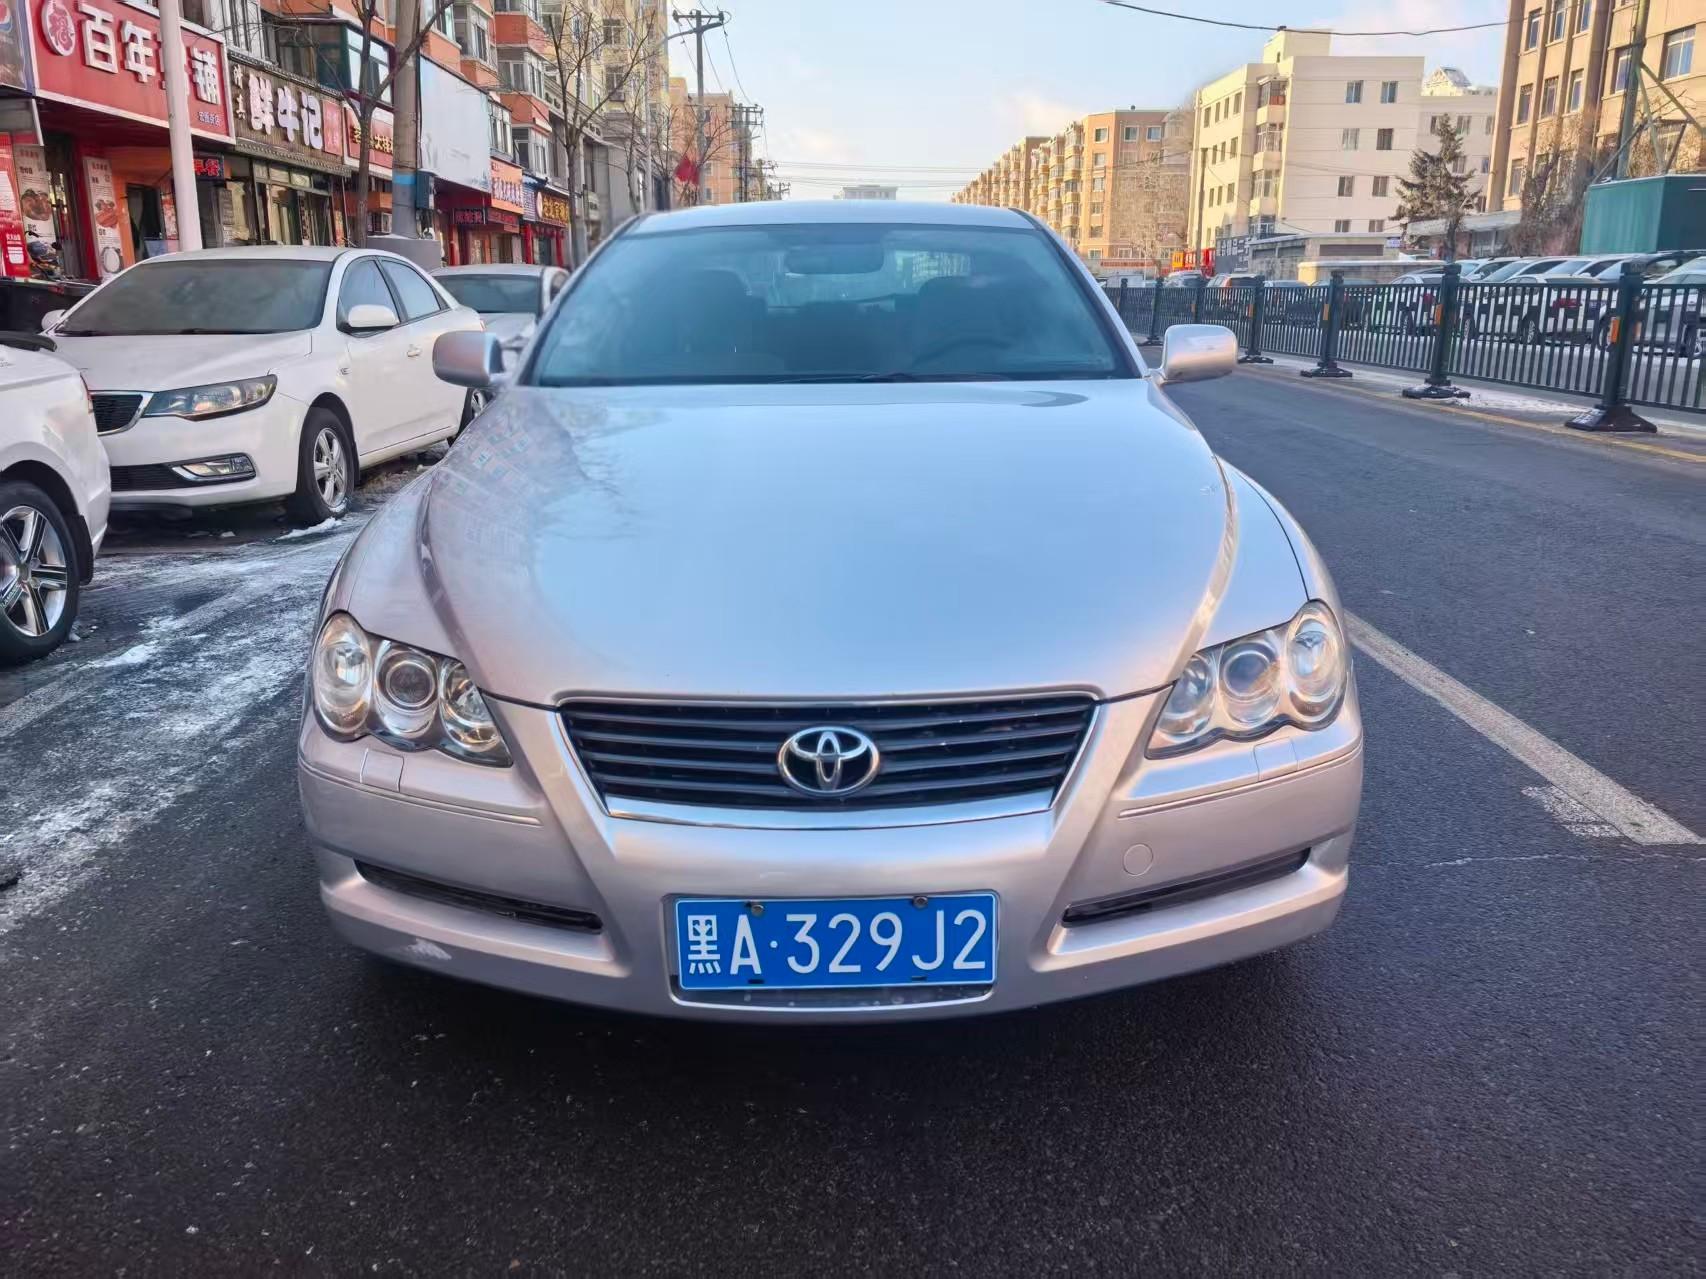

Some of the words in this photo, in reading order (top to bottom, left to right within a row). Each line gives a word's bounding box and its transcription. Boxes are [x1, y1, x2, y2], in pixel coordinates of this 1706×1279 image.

[78, 2, 221, 105] 百年铺
[249, 73, 323, 149] 鲜牛记
